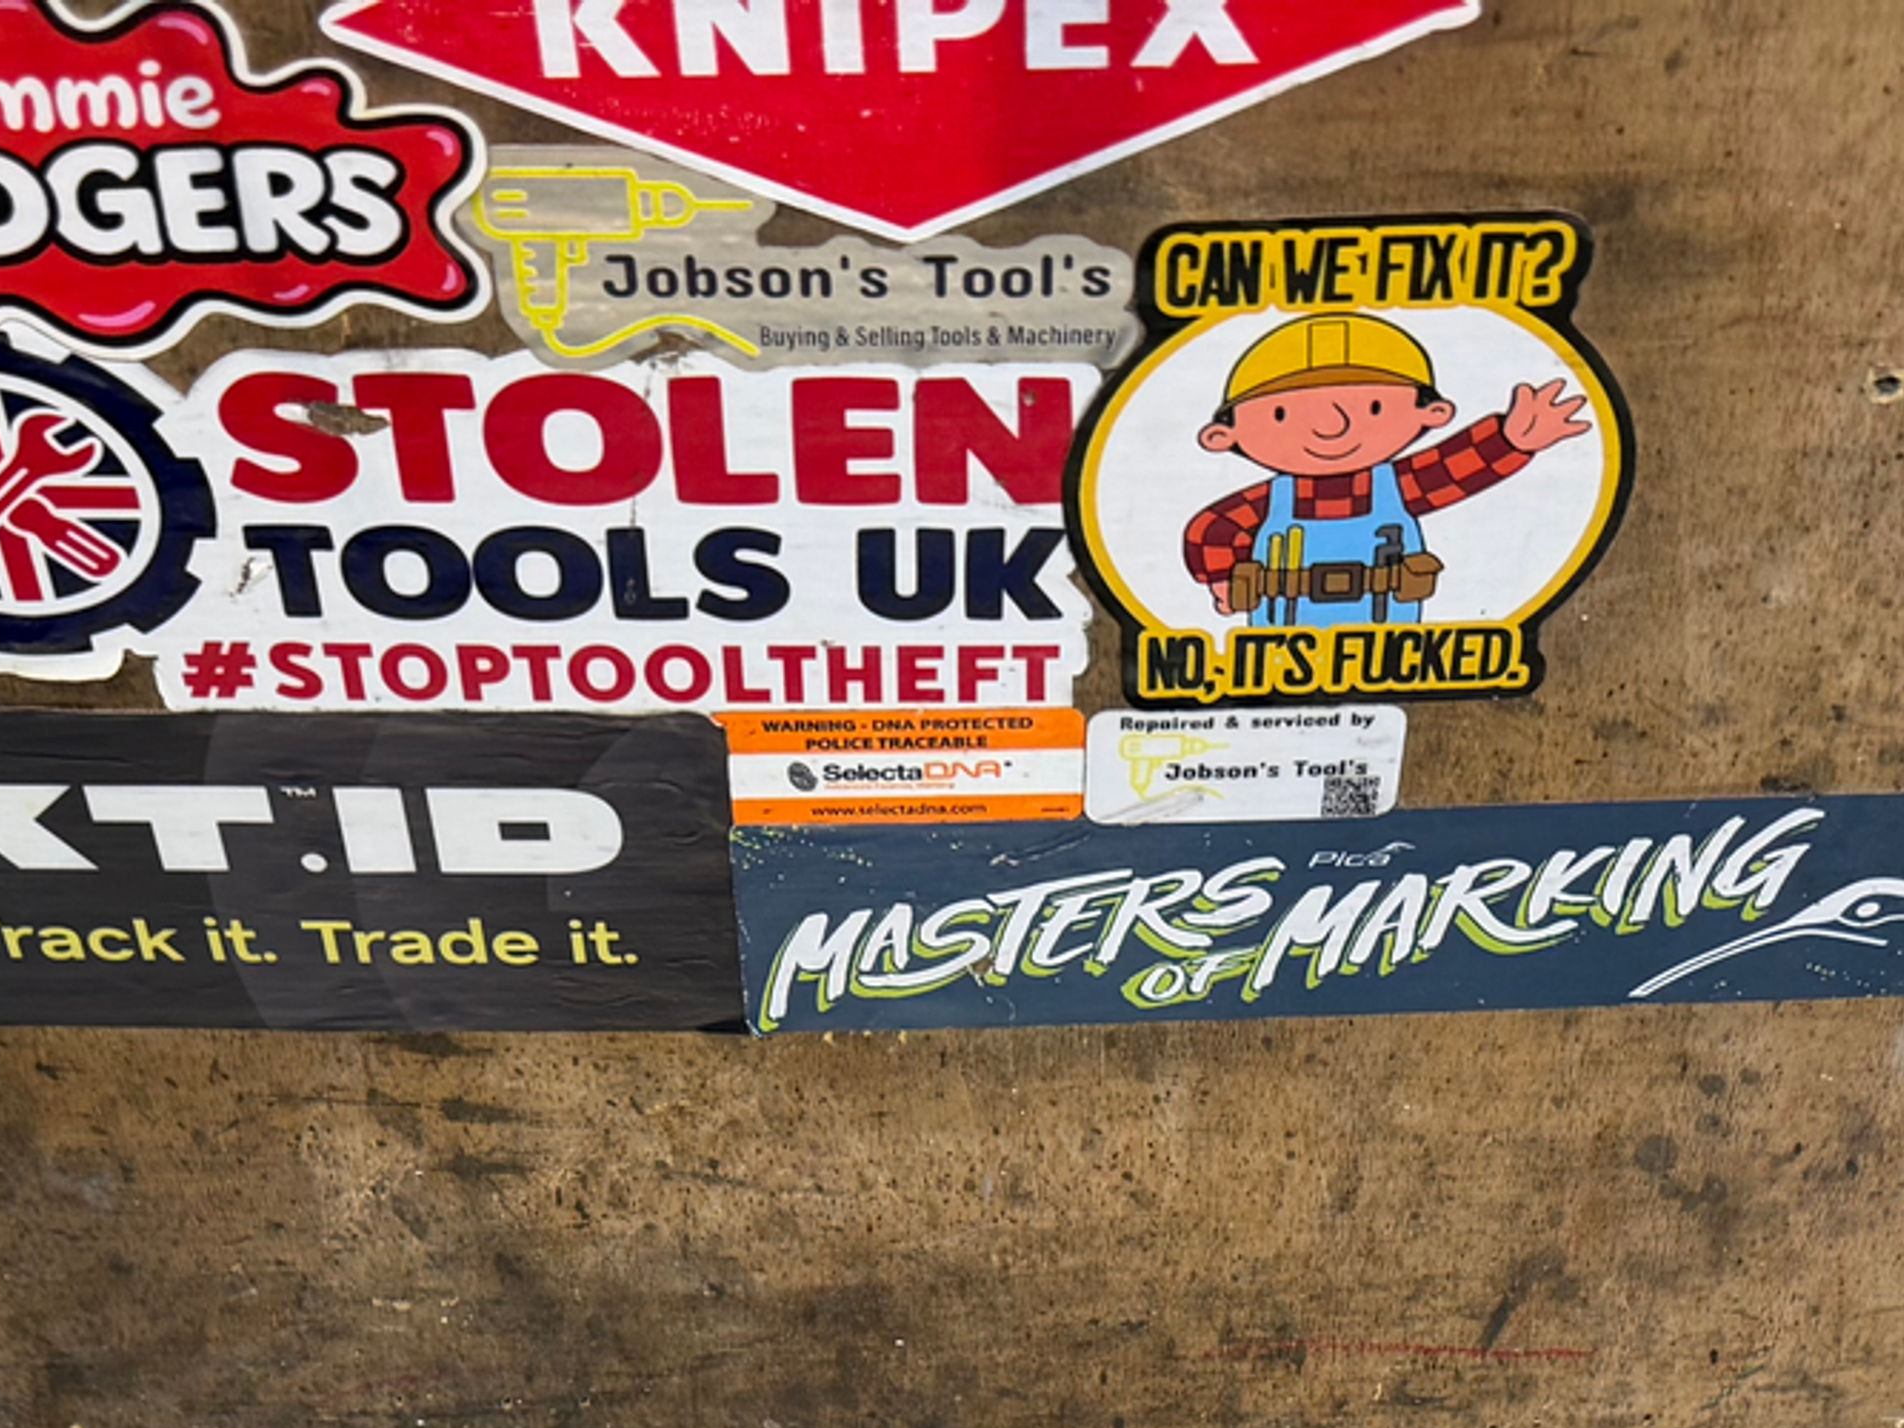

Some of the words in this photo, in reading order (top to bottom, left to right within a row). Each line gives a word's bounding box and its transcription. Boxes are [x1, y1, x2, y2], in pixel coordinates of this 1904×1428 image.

[603, 254, 889, 298] Jobson's
[923, 254, 1113, 298] Tool's
[1166, 239, 1262, 307] CAN
[1283, 236, 1359, 304] WE
[1375, 233, 1458, 302] FIX
[1473, 230, 1565, 301] IT?
[760, 326, 830, 350] Buying
[836, 327, 849, 346] &
[854, 325, 925, 351] Selling
[931, 325, 982, 347] Tools
[987, 327, 1000, 346] &
[1007, 325, 1118, 350] Machinery
[218, 371, 1074, 507] STOLEN
[243, 523, 792, 622] TOOLS
[856, 526, 1066, 622] UK
[182, 640, 1061, 704] #STOPTOOLTHEFT
[1146, 636, 1216, 695] NO,
[1232, 632, 1317, 690] IT'S
[1331, 628, 1520, 687] FUCKED.
[761, 719, 856, 733] WARNING
[872, 718, 916, 732] DNA
[921, 716, 1034, 732] PROTECTED
[805, 736, 873, 750] POLICE
[877, 735, 987, 749] TRACEABLE
[1120, 716, 1214, 733] Repaired
[1226, 716, 1240, 729] &
[1251, 713, 1340, 730] serviced
[1350, 712, 1375, 729] by
[1165, 762, 1280, 781] Jobson's
[1293, 759, 1369, 778] Tool's
[811, 803, 987, 817] www.selectadna.com
[1308, 850, 1392, 869] Pica
[764, 857, 1286, 1026] MASTERS
[1134, 948, 1258, 1003] OF
[1249, 808, 1825, 994] MARKING
[202, 915, 278, 963] it.
[299, 918, 540, 965] Trade
[568, 919, 640, 965] it.
